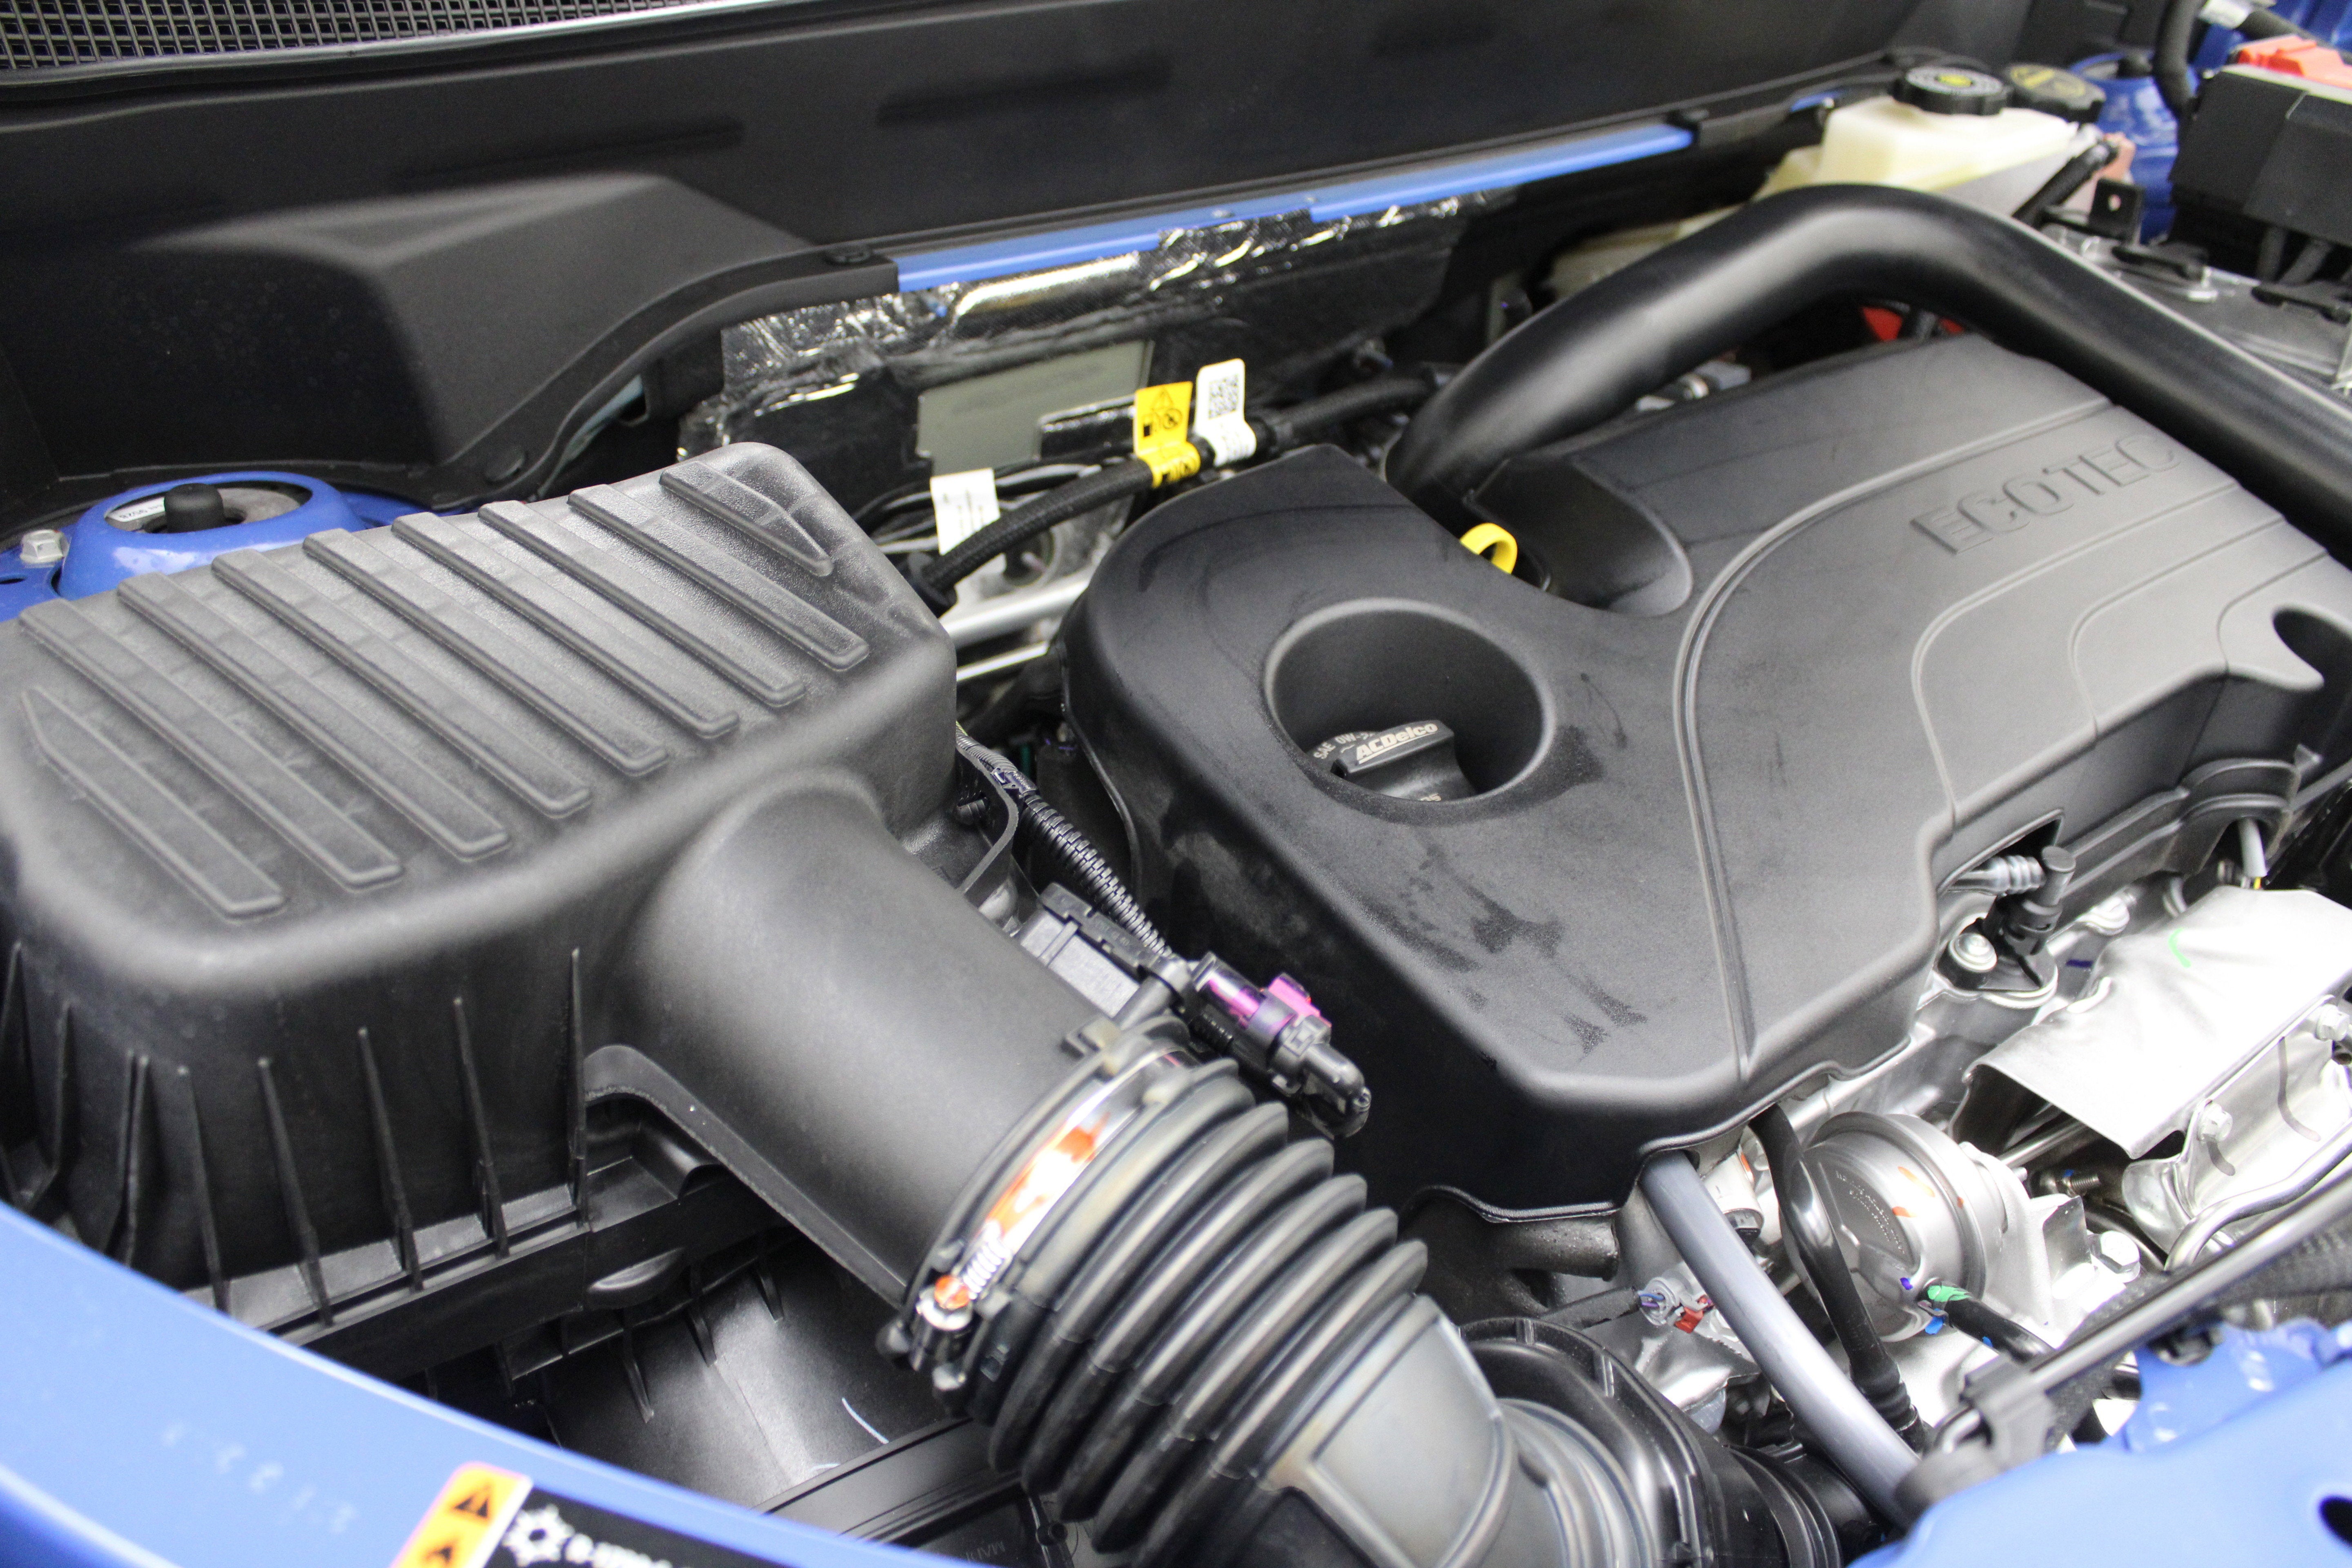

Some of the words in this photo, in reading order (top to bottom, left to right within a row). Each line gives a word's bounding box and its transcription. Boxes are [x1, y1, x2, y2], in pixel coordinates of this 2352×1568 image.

[1910, 434, 2181, 554] ECOTEC
[1313, 742, 1336, 759] SAE
[1356, 723, 1438, 761] ACDelco
